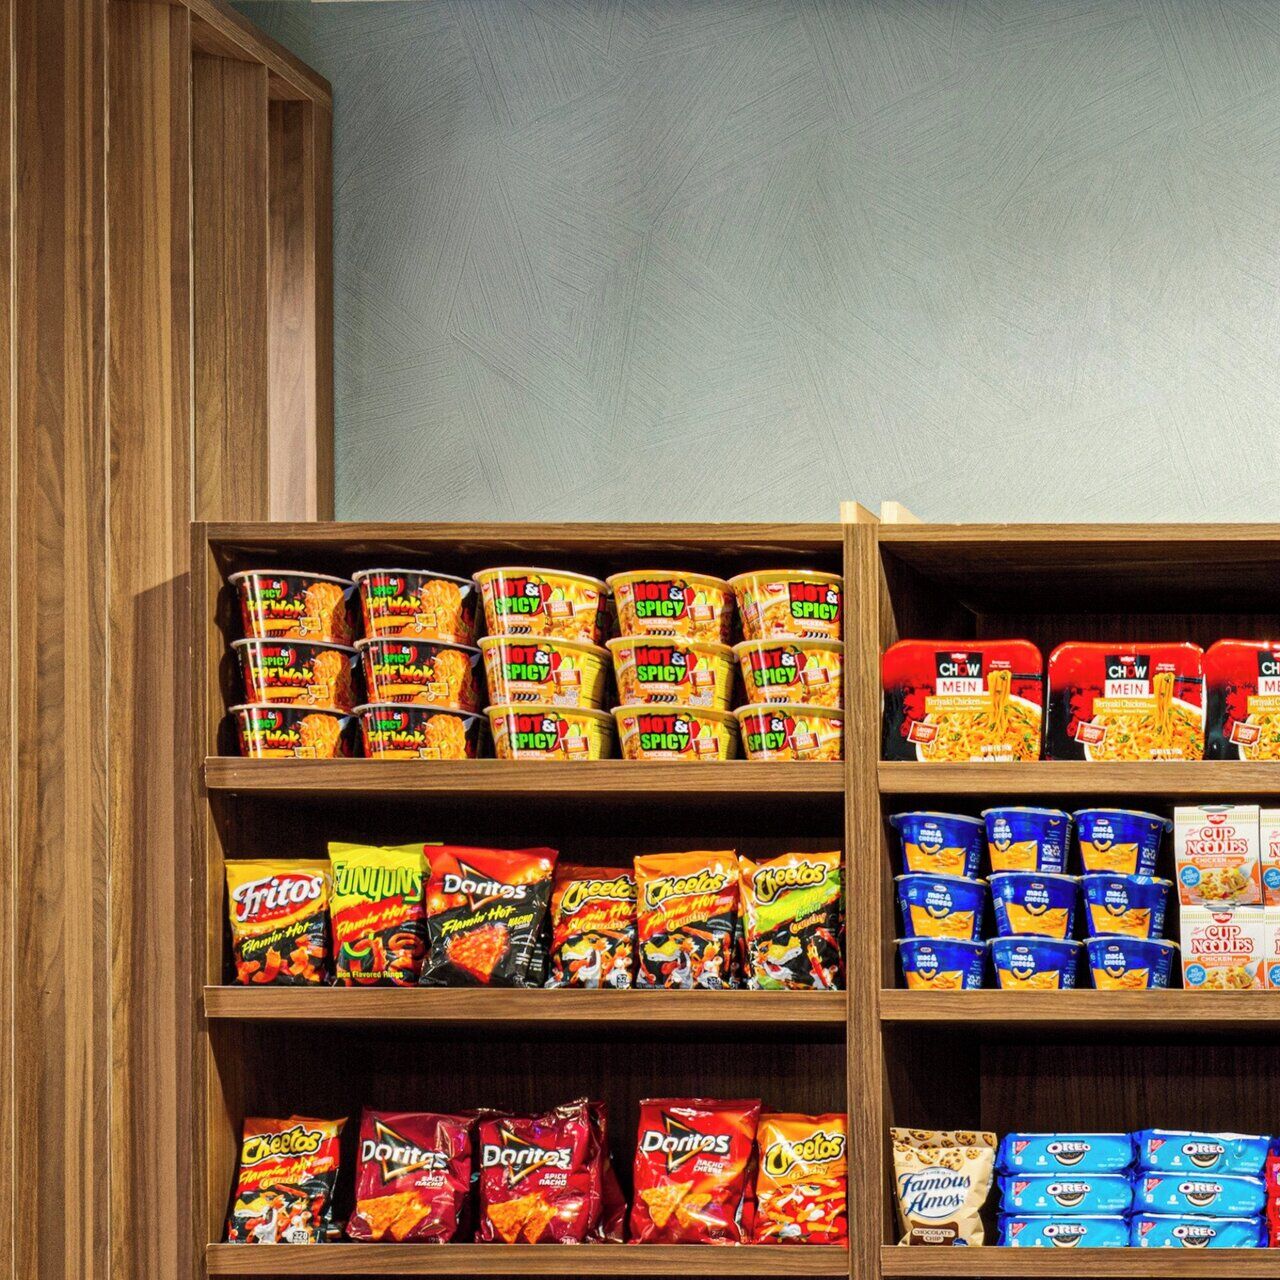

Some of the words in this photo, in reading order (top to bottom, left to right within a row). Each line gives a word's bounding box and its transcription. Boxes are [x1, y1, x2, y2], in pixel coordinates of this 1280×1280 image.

[636, 601, 683, 617] SPICY
[792, 602, 837, 619] SPICY
[638, 665, 684, 682] SPICY
[940, 662, 980, 676] CHOW
[1109, 666, 1147, 678] CHOW
[942, 682, 976, 692] MEIN
[1112, 683, 1143, 694] MEIN
[641, 733, 688, 749] SPICY
[1201, 827, 1235, 840] CUP
[1186, 840, 1247, 855] NOODLES
[444, 874, 526, 899] Doritos
[646, 871, 727, 908] Cheetos
[754, 861, 826, 904] Cheetos
[233, 875, 322, 921] Fritos
[381, 905, 406, 920] Hot
[488, 905, 516, 920] Hot
[286, 922, 311, 938] Hot
[1205, 926, 1241, 940] CUP
[1191, 938, 1253, 954] NOODLES
[242, 1125, 322, 1166] Cheetos
[643, 1132, 730, 1153] Doritos
[1047, 1142, 1091, 1153] OREO
[362, 1141, 449, 1170] Doritos
[484, 1145, 571, 1167] Doritos
[766, 1134, 842, 1174] Cheetos
[899, 1172, 971, 1199] Famous
[1047, 1183, 1091, 1194] OREO
[1179, 1183, 1222, 1194] OREO
[904, 1194, 960, 1218] Amos
[1043, 1225, 1087, 1236] OREO
[1172, 1226, 1215, 1238] OREO
